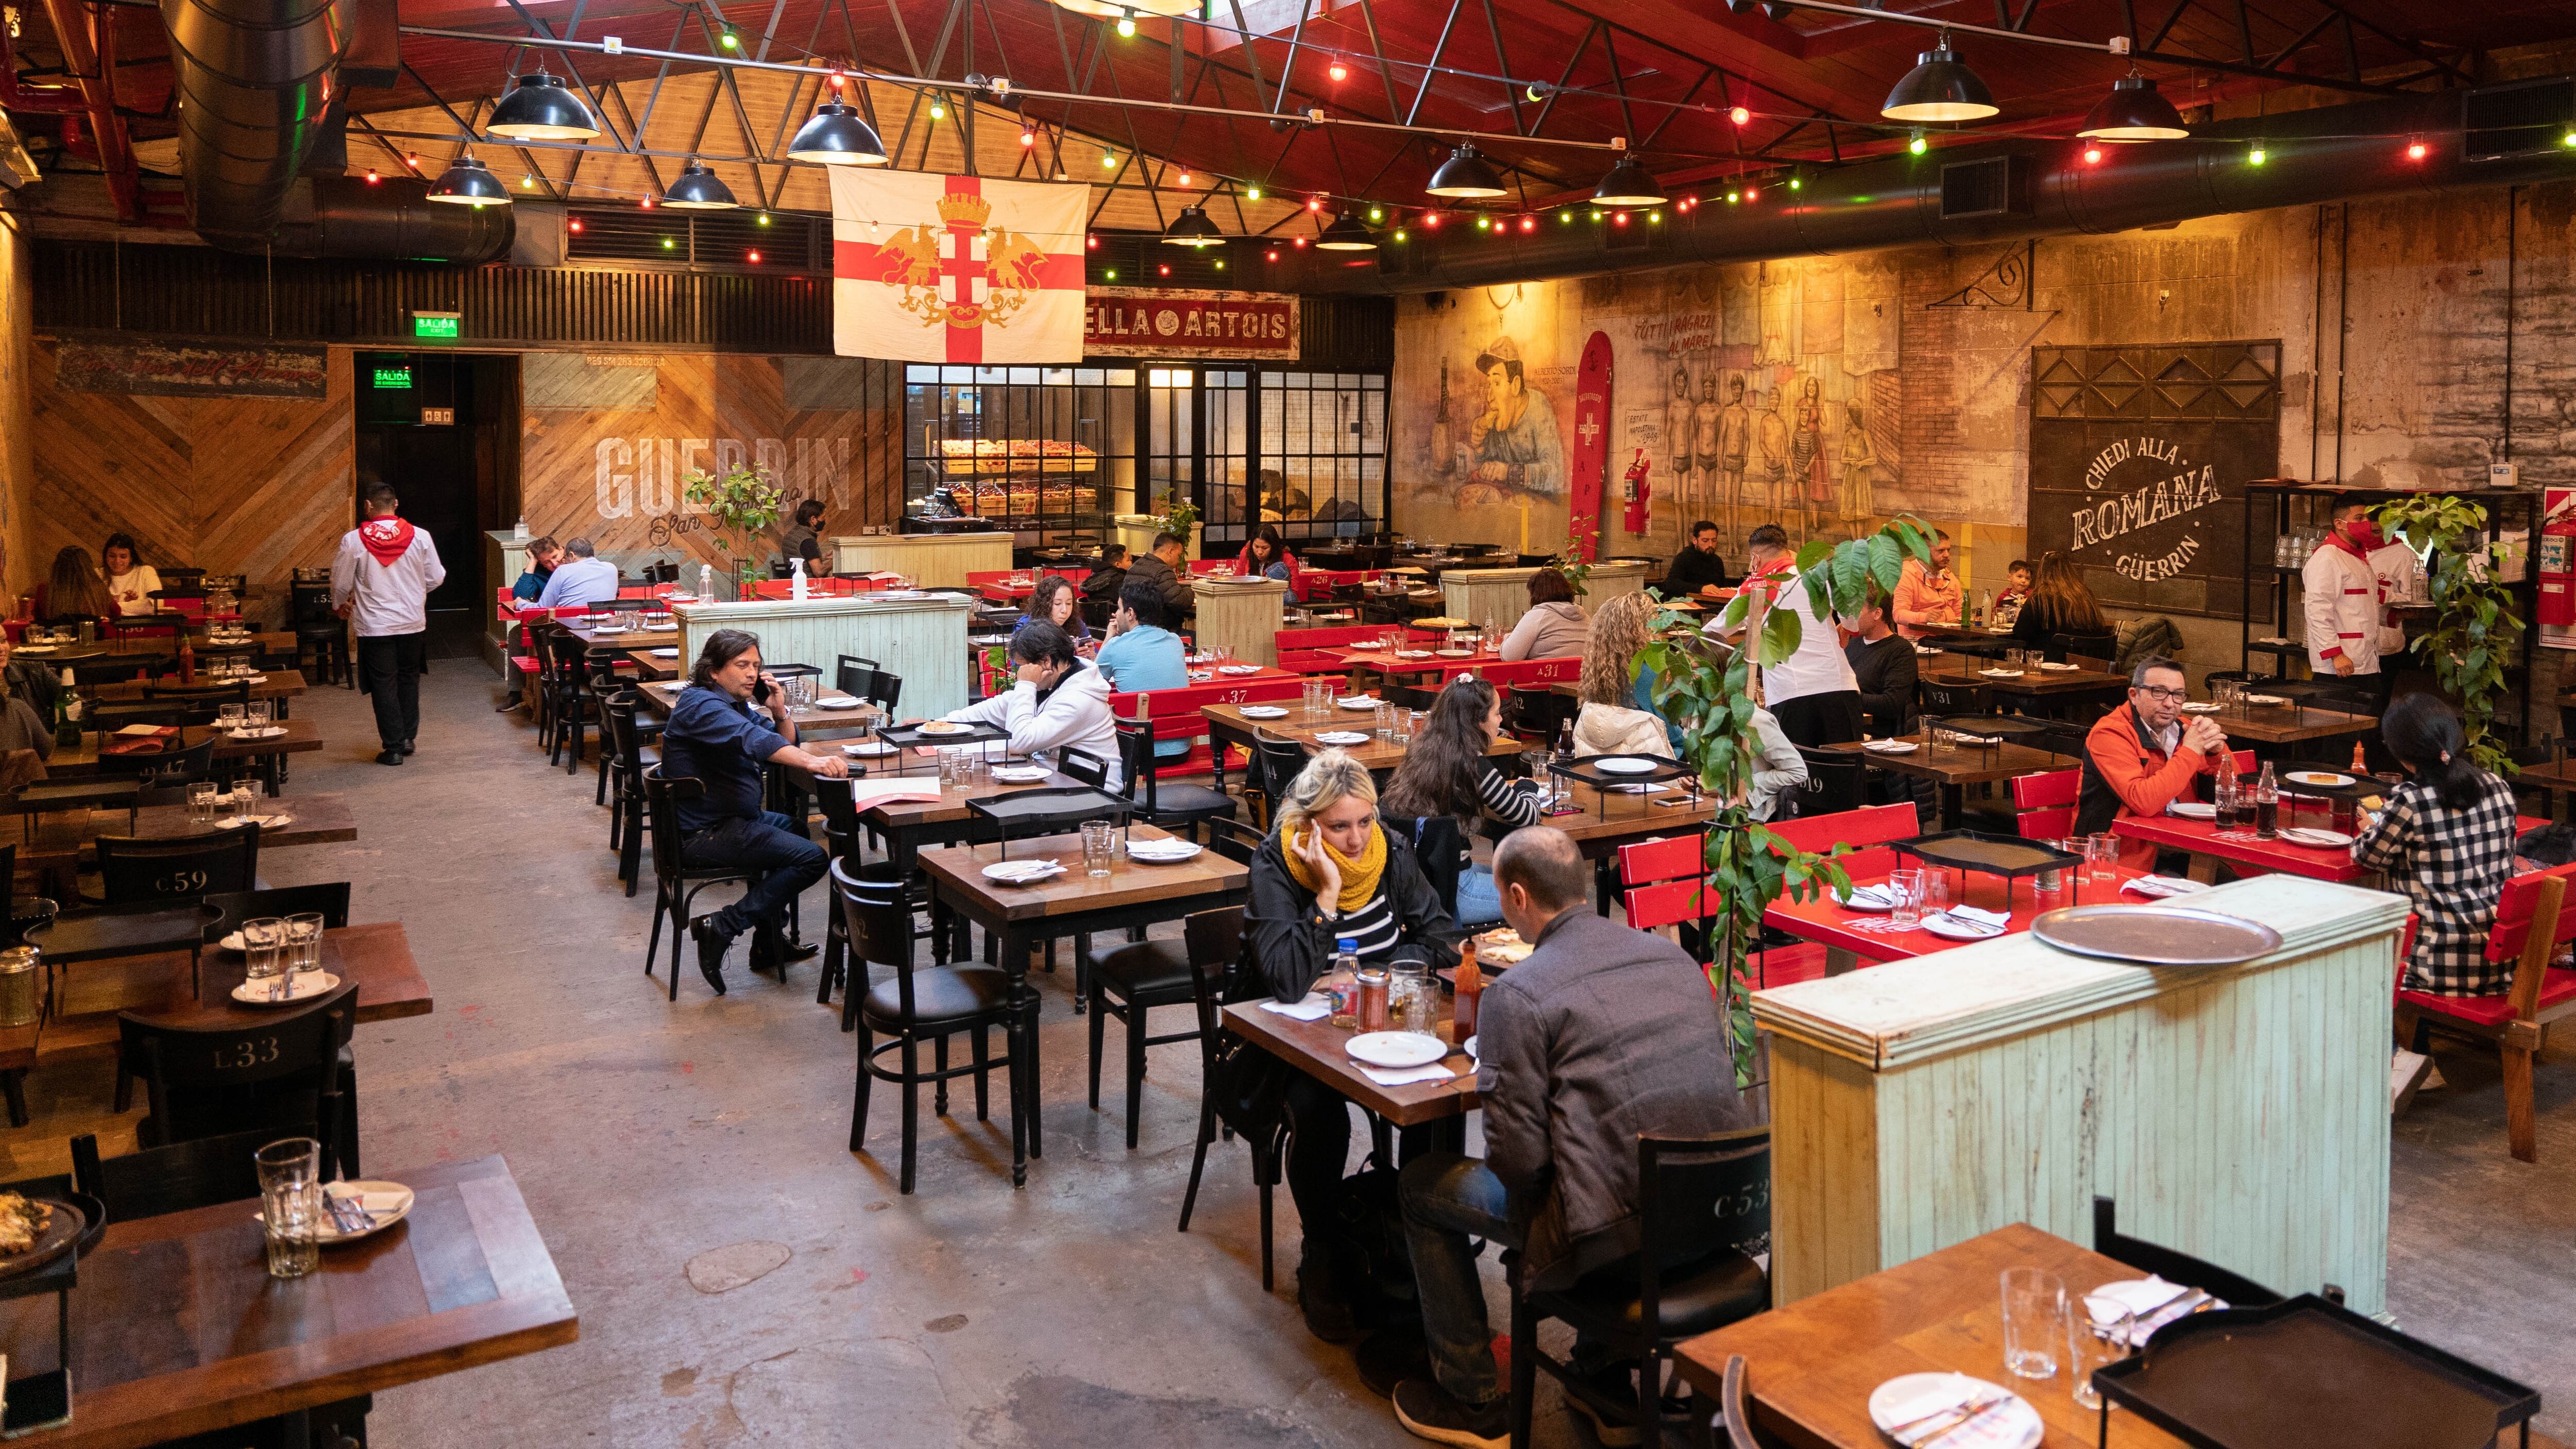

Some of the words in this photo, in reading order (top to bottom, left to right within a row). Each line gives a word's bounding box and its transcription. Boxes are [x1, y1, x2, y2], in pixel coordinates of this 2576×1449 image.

[418, 318, 455, 328] SALIDA
[1184, 311, 1286, 339] ARTOIS
[1675, 314, 1716, 333] RAGAZZI
[1669, 340, 1680, 354] AL
[1534, 367, 1557, 375] ALBERTO
[1558, 366, 1577, 375] SORDI
[2086, 439, 2130, 490] CHIEDI
[2137, 437, 2179, 465] ALLA
[596, 437, 850, 519] GUERRIN
[2071, 464, 2222, 552] ROMANA
[649, 514, 702, 548] San
[2115, 534, 2200, 582] GÜERRIN
[1311, 575, 1328, 584] A26
[1537, 665, 1558, 677] A31
